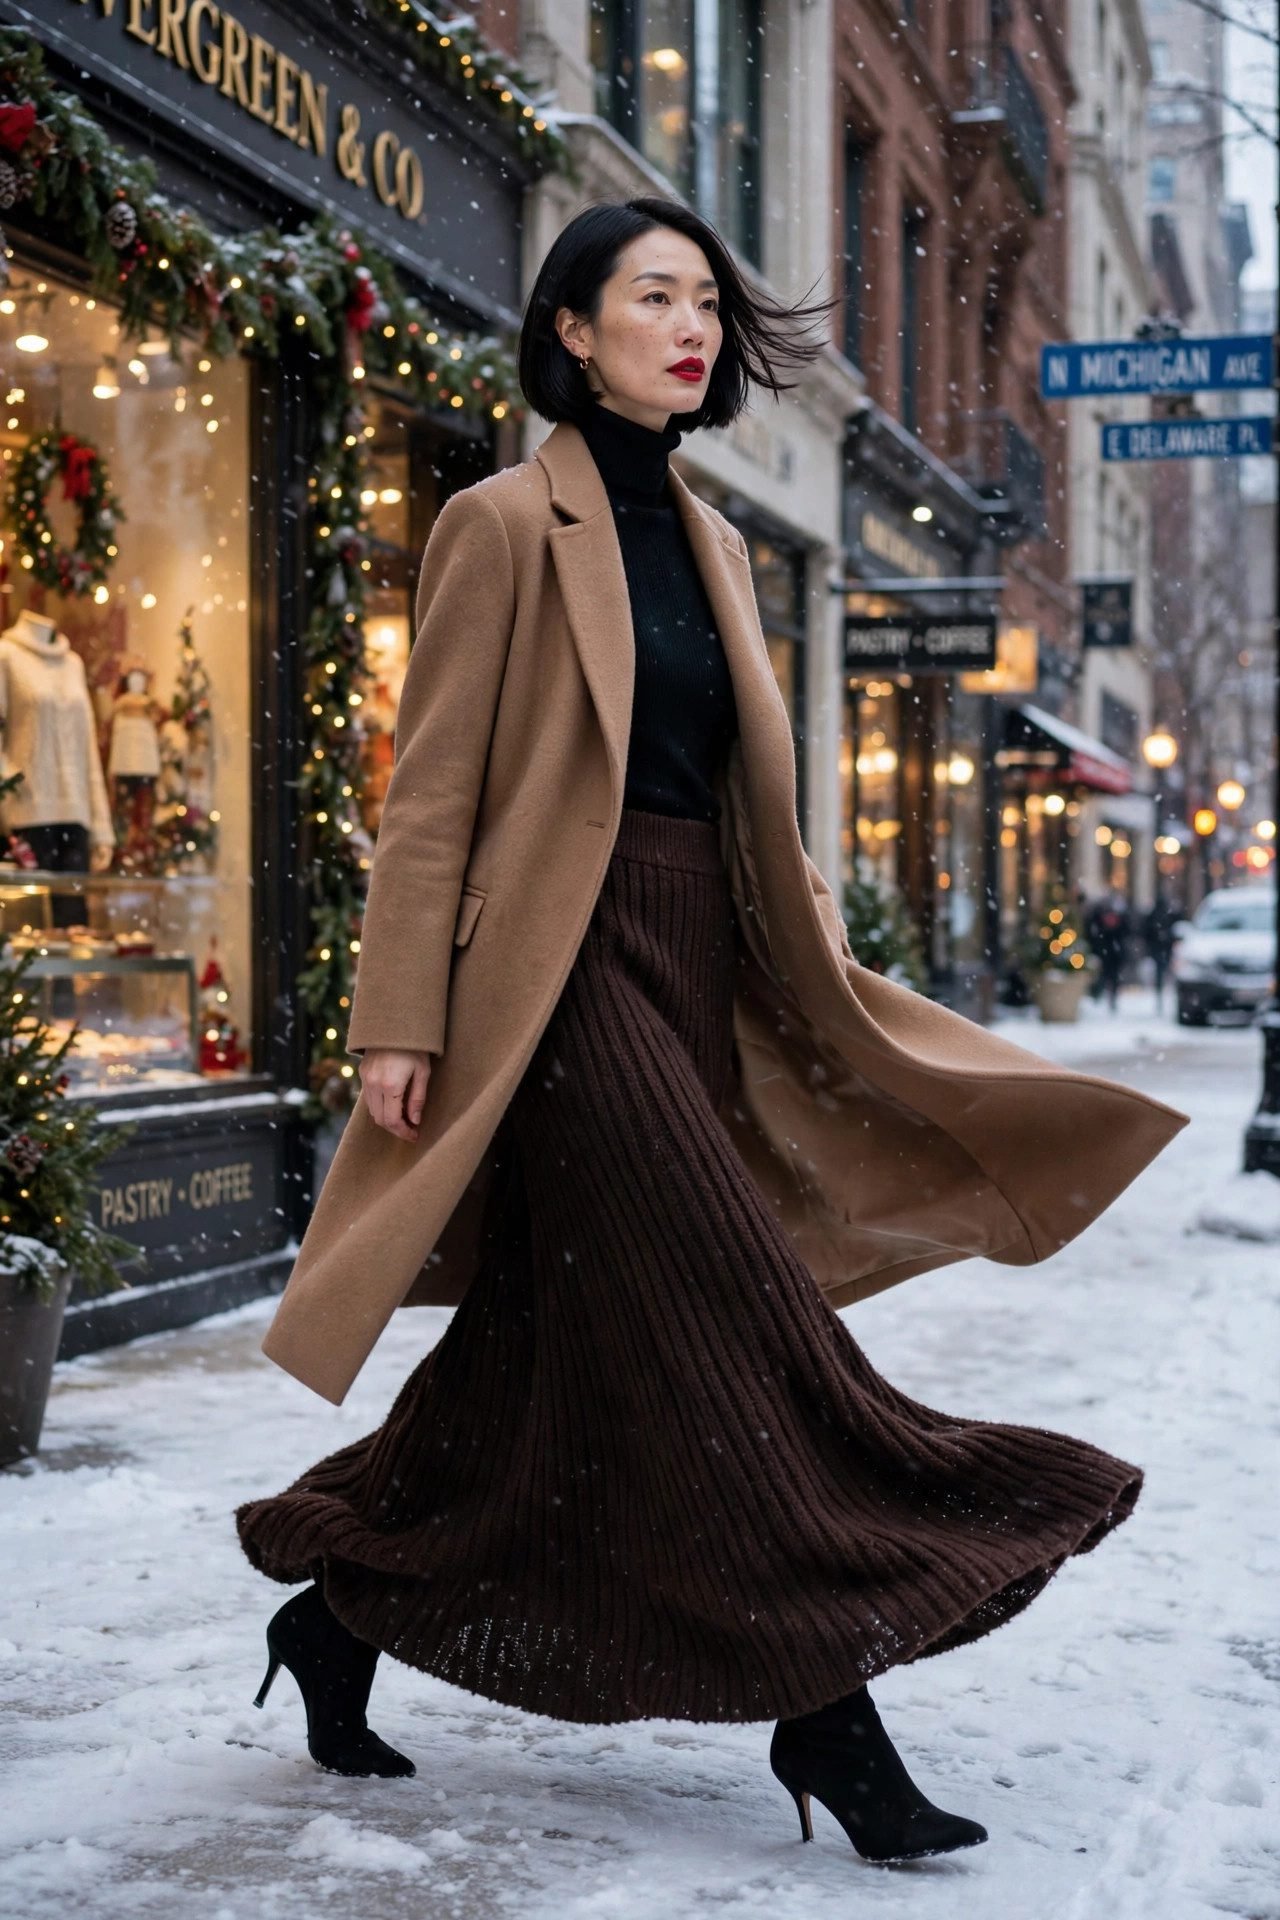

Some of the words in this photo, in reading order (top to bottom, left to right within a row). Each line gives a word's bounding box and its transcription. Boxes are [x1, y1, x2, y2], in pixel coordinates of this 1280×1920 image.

[79, 0, 328, 157] ERGREEN
[337, 103, 367, 188] &
[1048, 356, 1069, 389] N
[1080, 347, 1210, 388] MICHIGAN
[1223, 352, 1263, 382] AVE
[1107, 428, 1122, 458] E
[1129, 423, 1231, 457] DELAWARE
[101, 1178, 173, 1228] PASTRY
[189, 1162, 253, 1210] COFFEE
